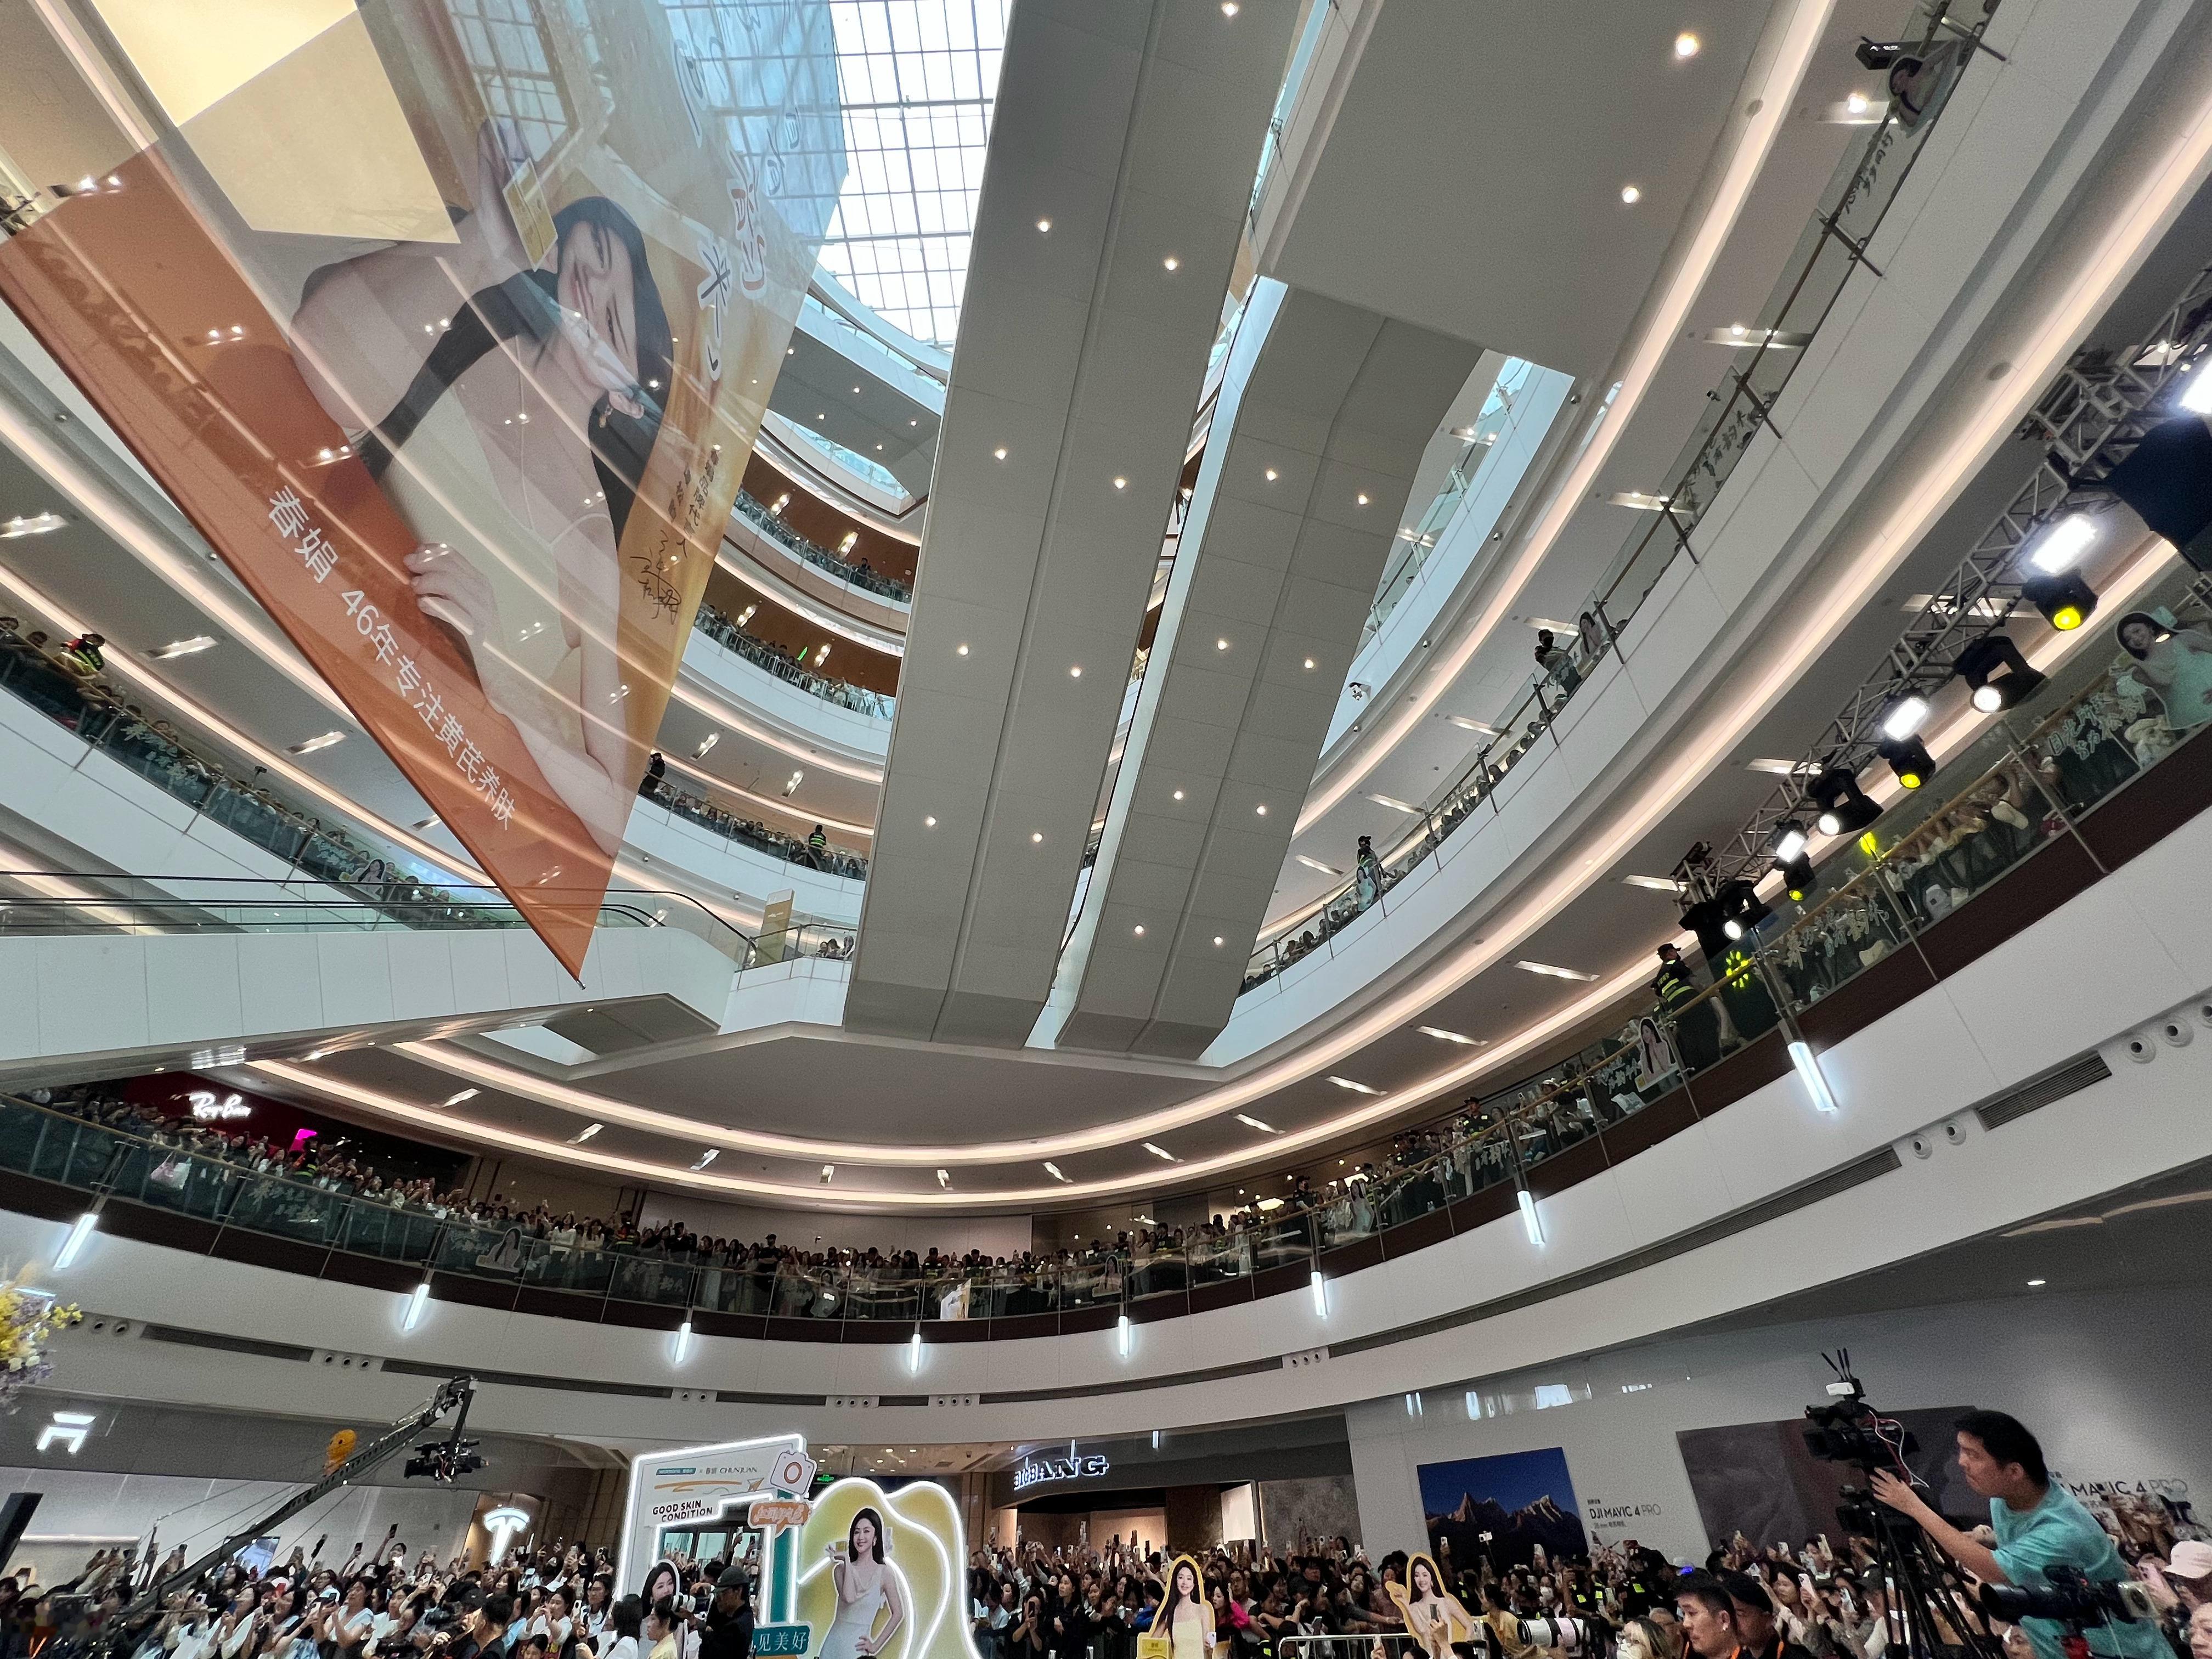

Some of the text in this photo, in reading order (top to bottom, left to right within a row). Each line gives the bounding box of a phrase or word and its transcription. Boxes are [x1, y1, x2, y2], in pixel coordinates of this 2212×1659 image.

[269, 485, 515, 830] 春娟 46年专注黄芪养肤
[2069, 1480, 2132, 1497] MAIC
[653, 1499, 702, 1515] GOOD SKIN
[662, 1507, 713, 1522] CONDITION
[1589, 1504, 1661, 1519] DJI MAVIC 4 PRO
[757, 1632, 807, 1651] 见美好
